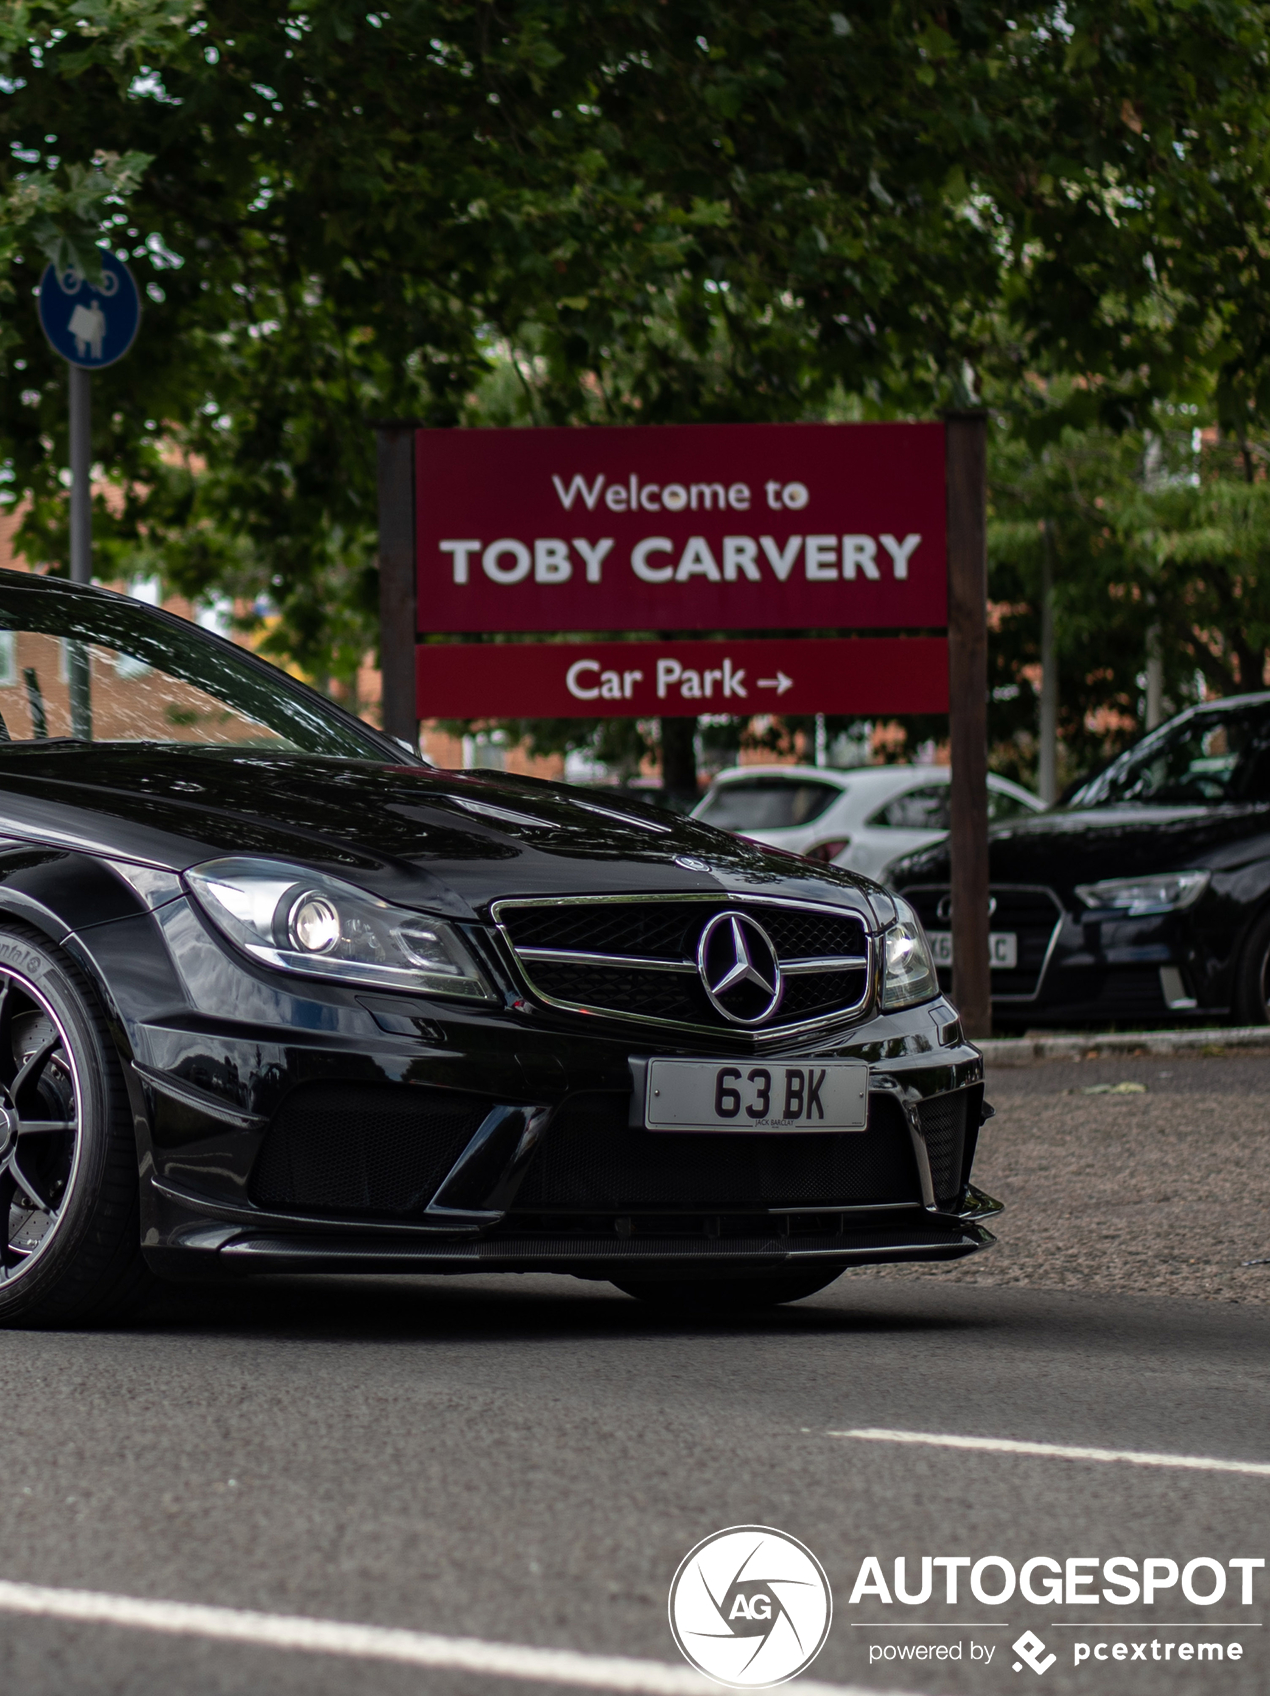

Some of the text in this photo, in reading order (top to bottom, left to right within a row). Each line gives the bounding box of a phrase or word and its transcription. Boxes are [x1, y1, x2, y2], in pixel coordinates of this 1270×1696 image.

[553, 475, 809, 512] Welcome to
[439, 533, 922, 584] TOBY CARVERY
[566, 658, 748, 700] Car Park
[714, 1066, 827, 1120] 63 BK
[754, 1118, 795, 1128] JACK BARCLAY
